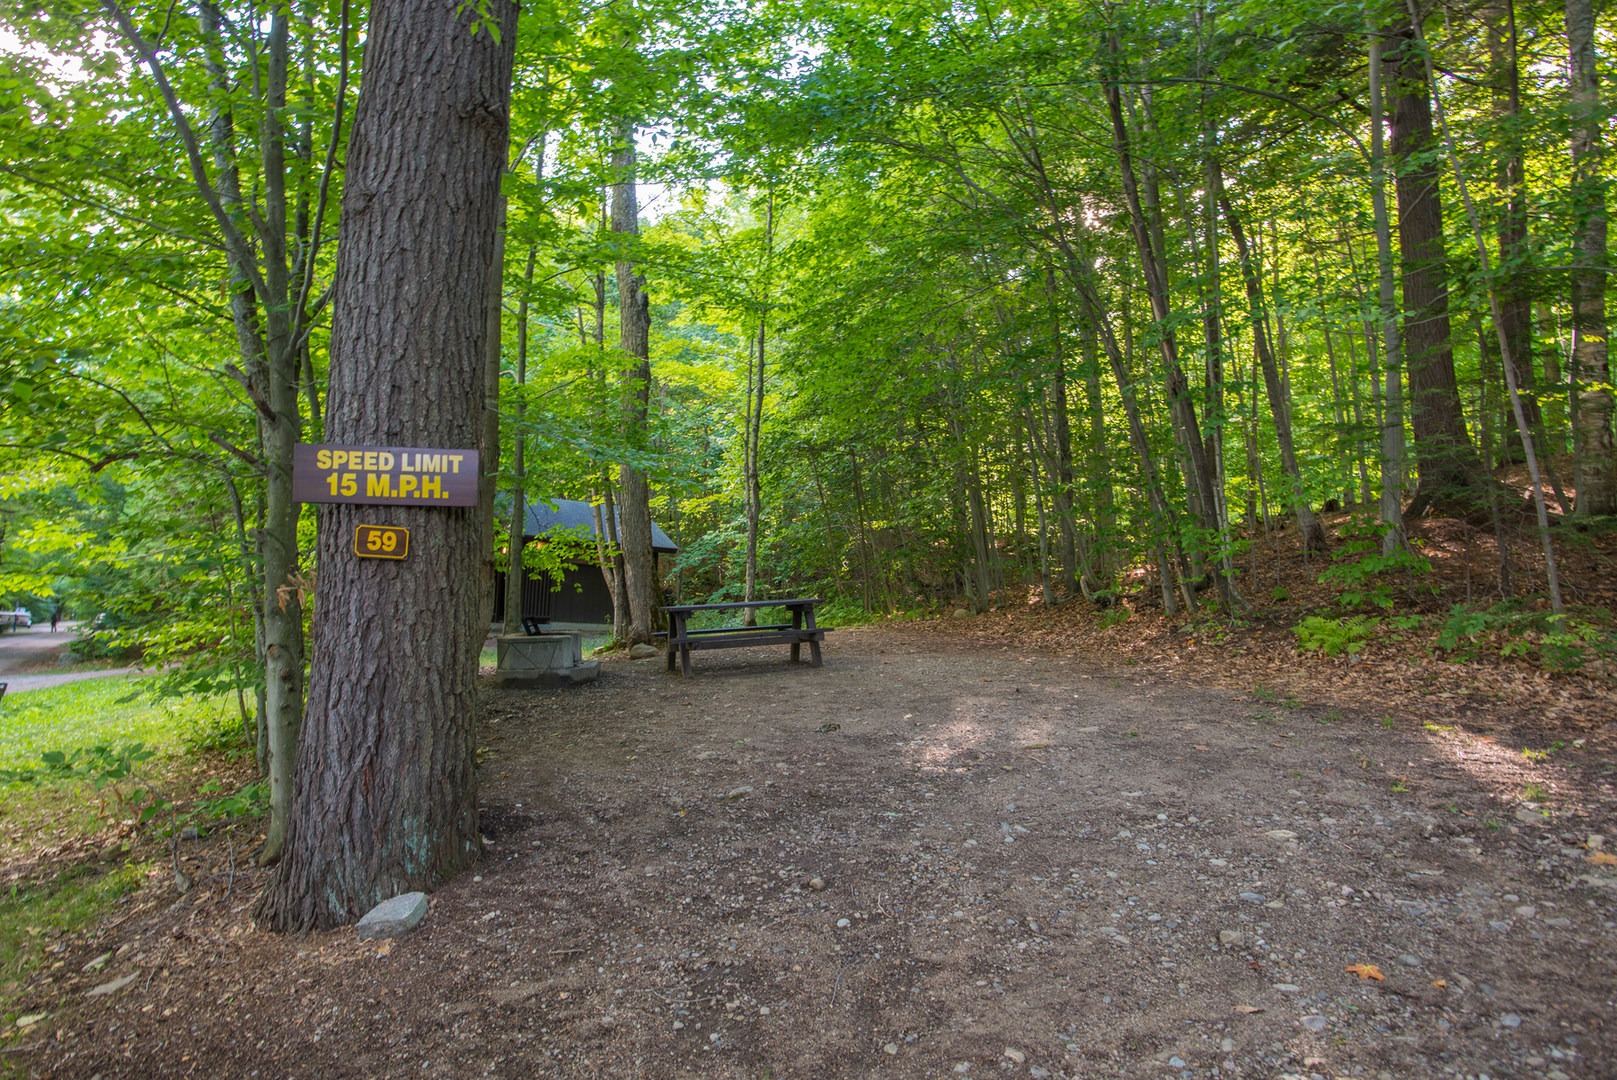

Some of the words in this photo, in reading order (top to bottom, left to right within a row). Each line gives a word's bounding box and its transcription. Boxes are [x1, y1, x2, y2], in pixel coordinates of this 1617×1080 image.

[316, 449, 395, 471] SPEED
[401, 453, 463, 473] LIMIT
[326, 472, 358, 497] 15
[366, 473, 449, 499] M.P.H.
[366, 530, 397, 552] 59
